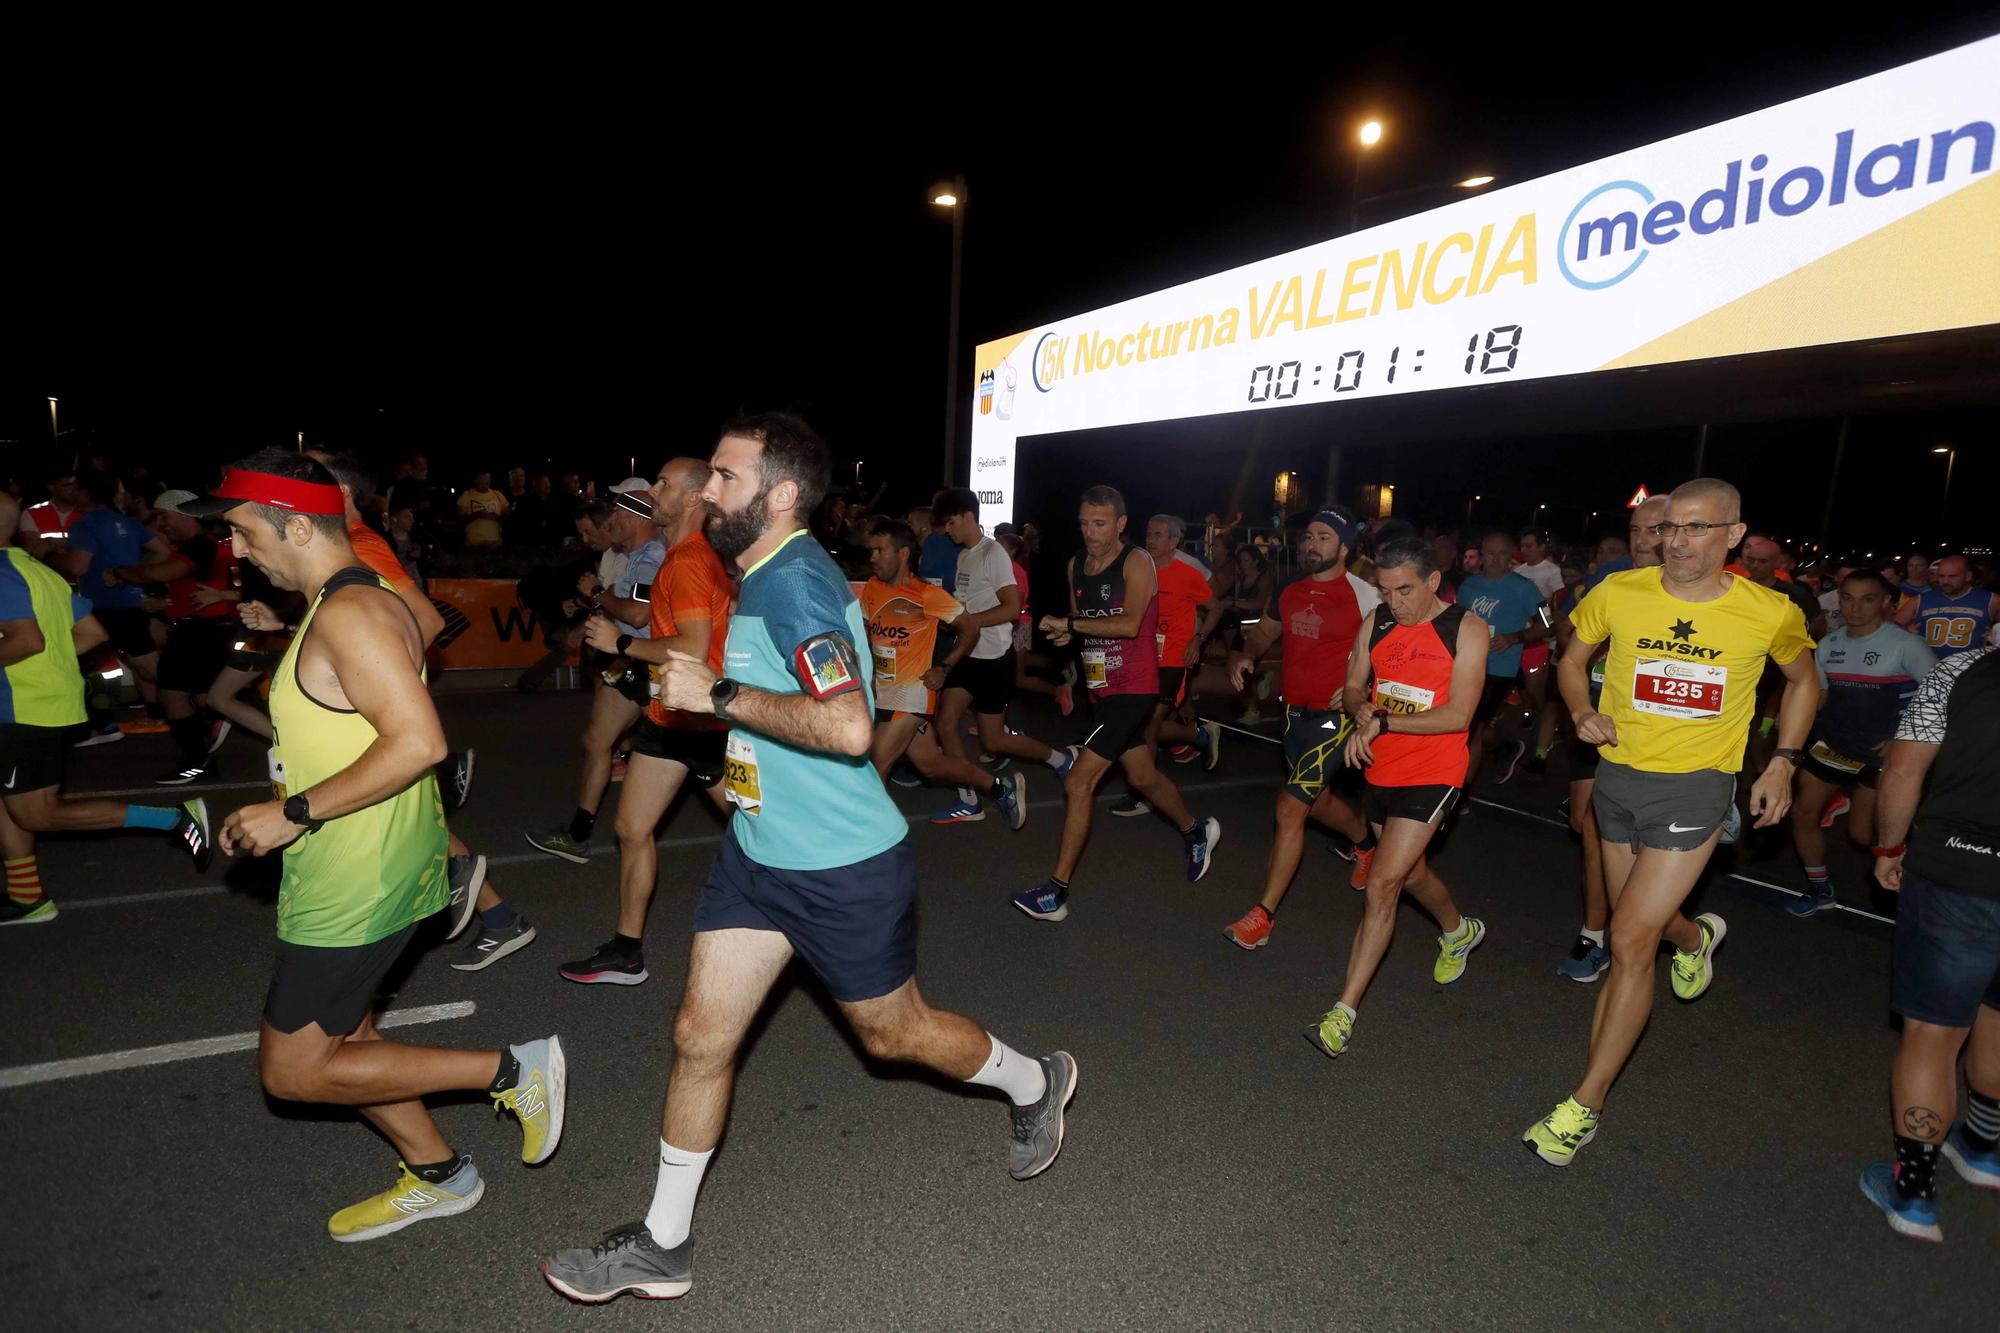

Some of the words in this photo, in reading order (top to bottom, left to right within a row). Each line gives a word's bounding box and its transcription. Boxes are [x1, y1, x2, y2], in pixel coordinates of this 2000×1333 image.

[1040, 336, 1070, 385] 15K
[1073, 307, 1240, 376] Nocturna
[1249, 213, 1538, 340] VALENCIA
[1926, 617, 1976, 648] 09
[1636, 638, 1723, 660] SAYSKY
[1652, 679, 1703, 699] 1.235
[1383, 697, 1415, 714] 4.770
[1945, 836, 1992, 854] Nunca
